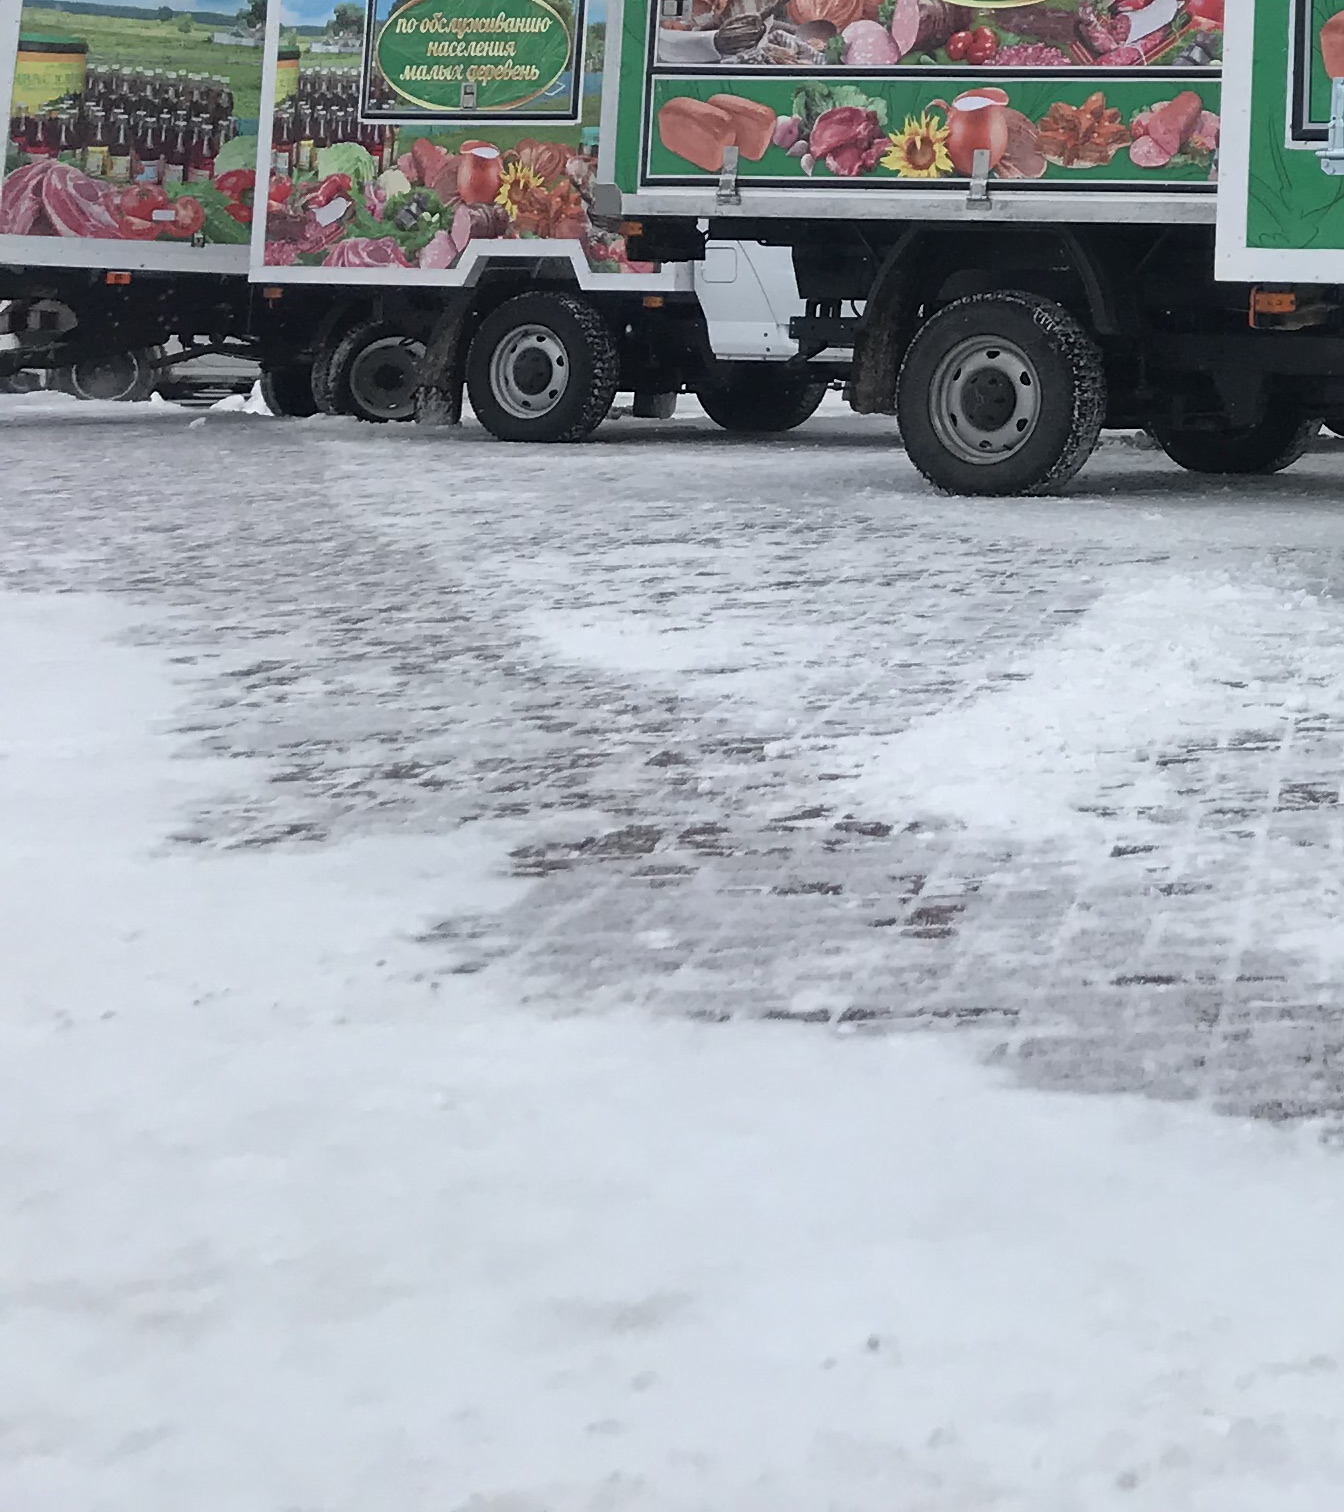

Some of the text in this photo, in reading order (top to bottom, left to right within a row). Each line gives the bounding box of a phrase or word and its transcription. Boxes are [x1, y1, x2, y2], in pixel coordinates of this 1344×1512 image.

[396, 12, 552, 38] по обслуживанию
[426, 40, 516, 57] населения
[400, 62, 540, 86] малых деревень
